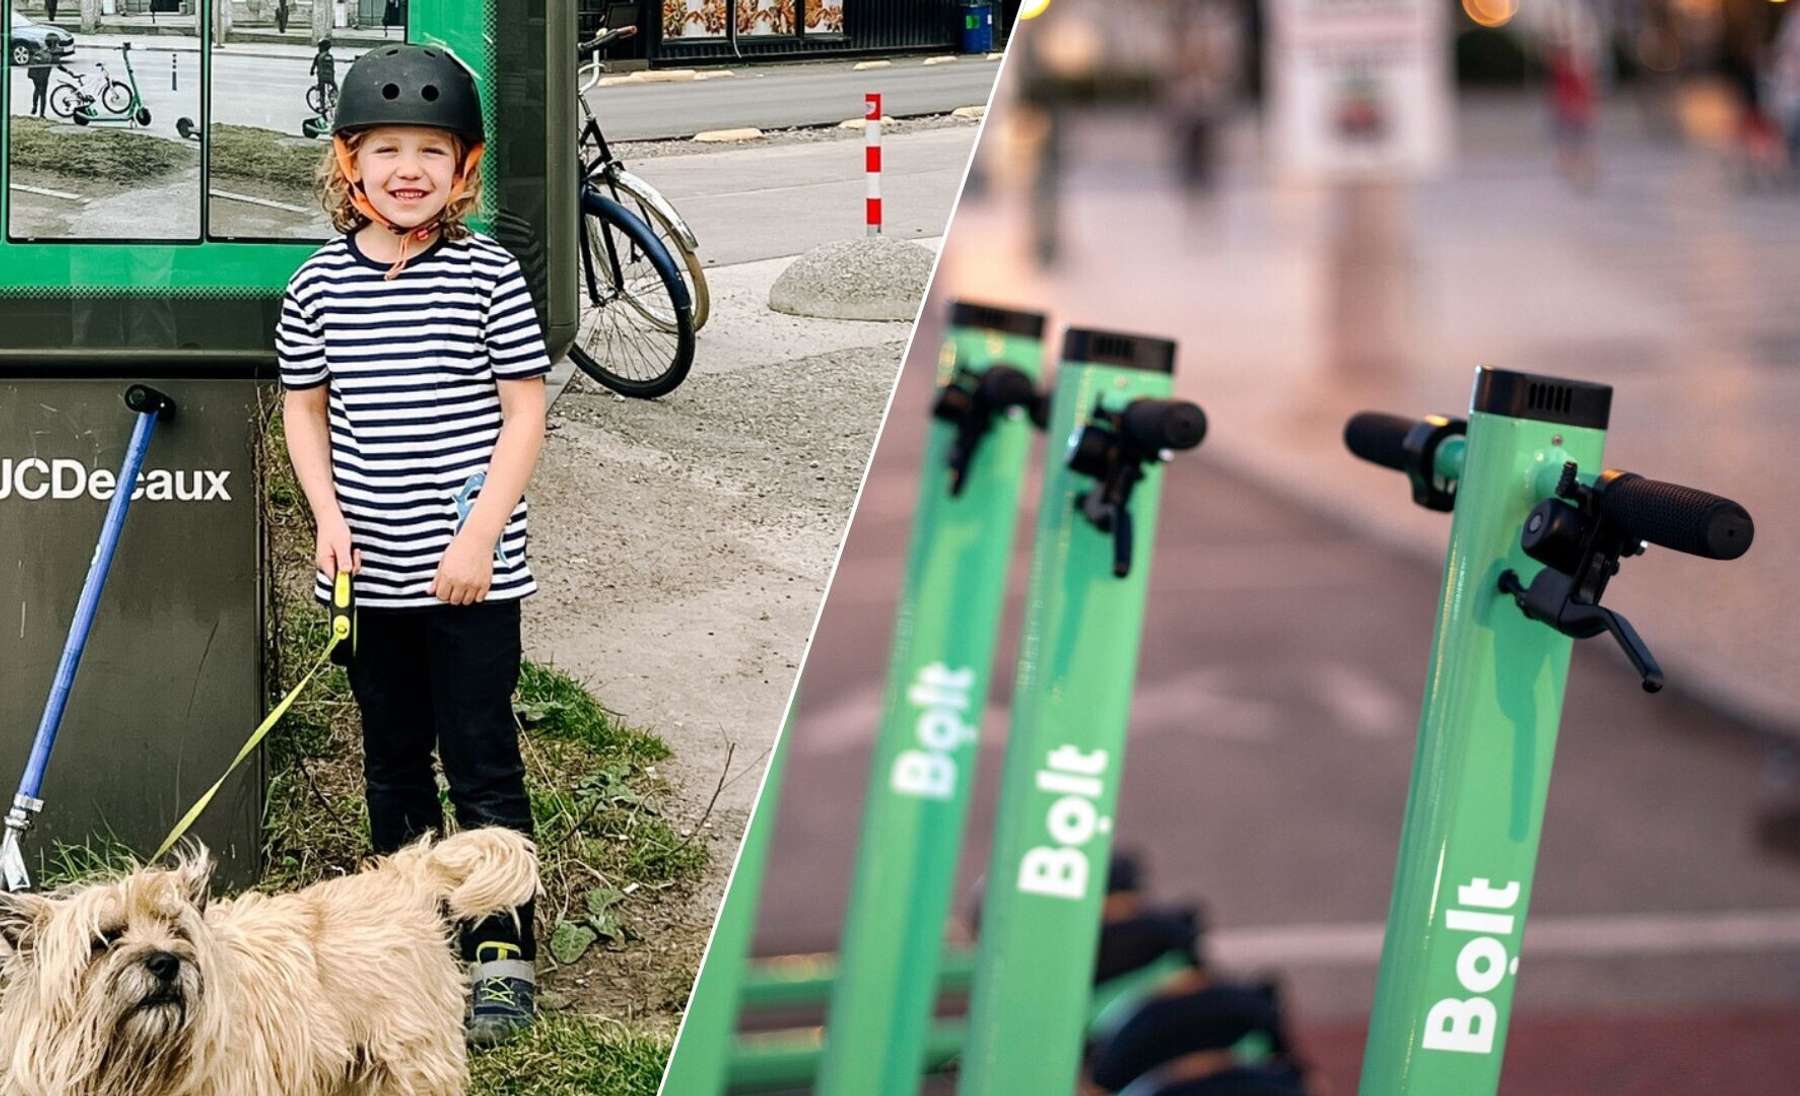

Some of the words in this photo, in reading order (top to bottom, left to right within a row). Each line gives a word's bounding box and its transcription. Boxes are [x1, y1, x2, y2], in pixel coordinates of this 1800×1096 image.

[890, 662, 976, 799] Bolt
[1017, 745, 1110, 901] Bolt
[1421, 876, 1521, 1054] Bolt
